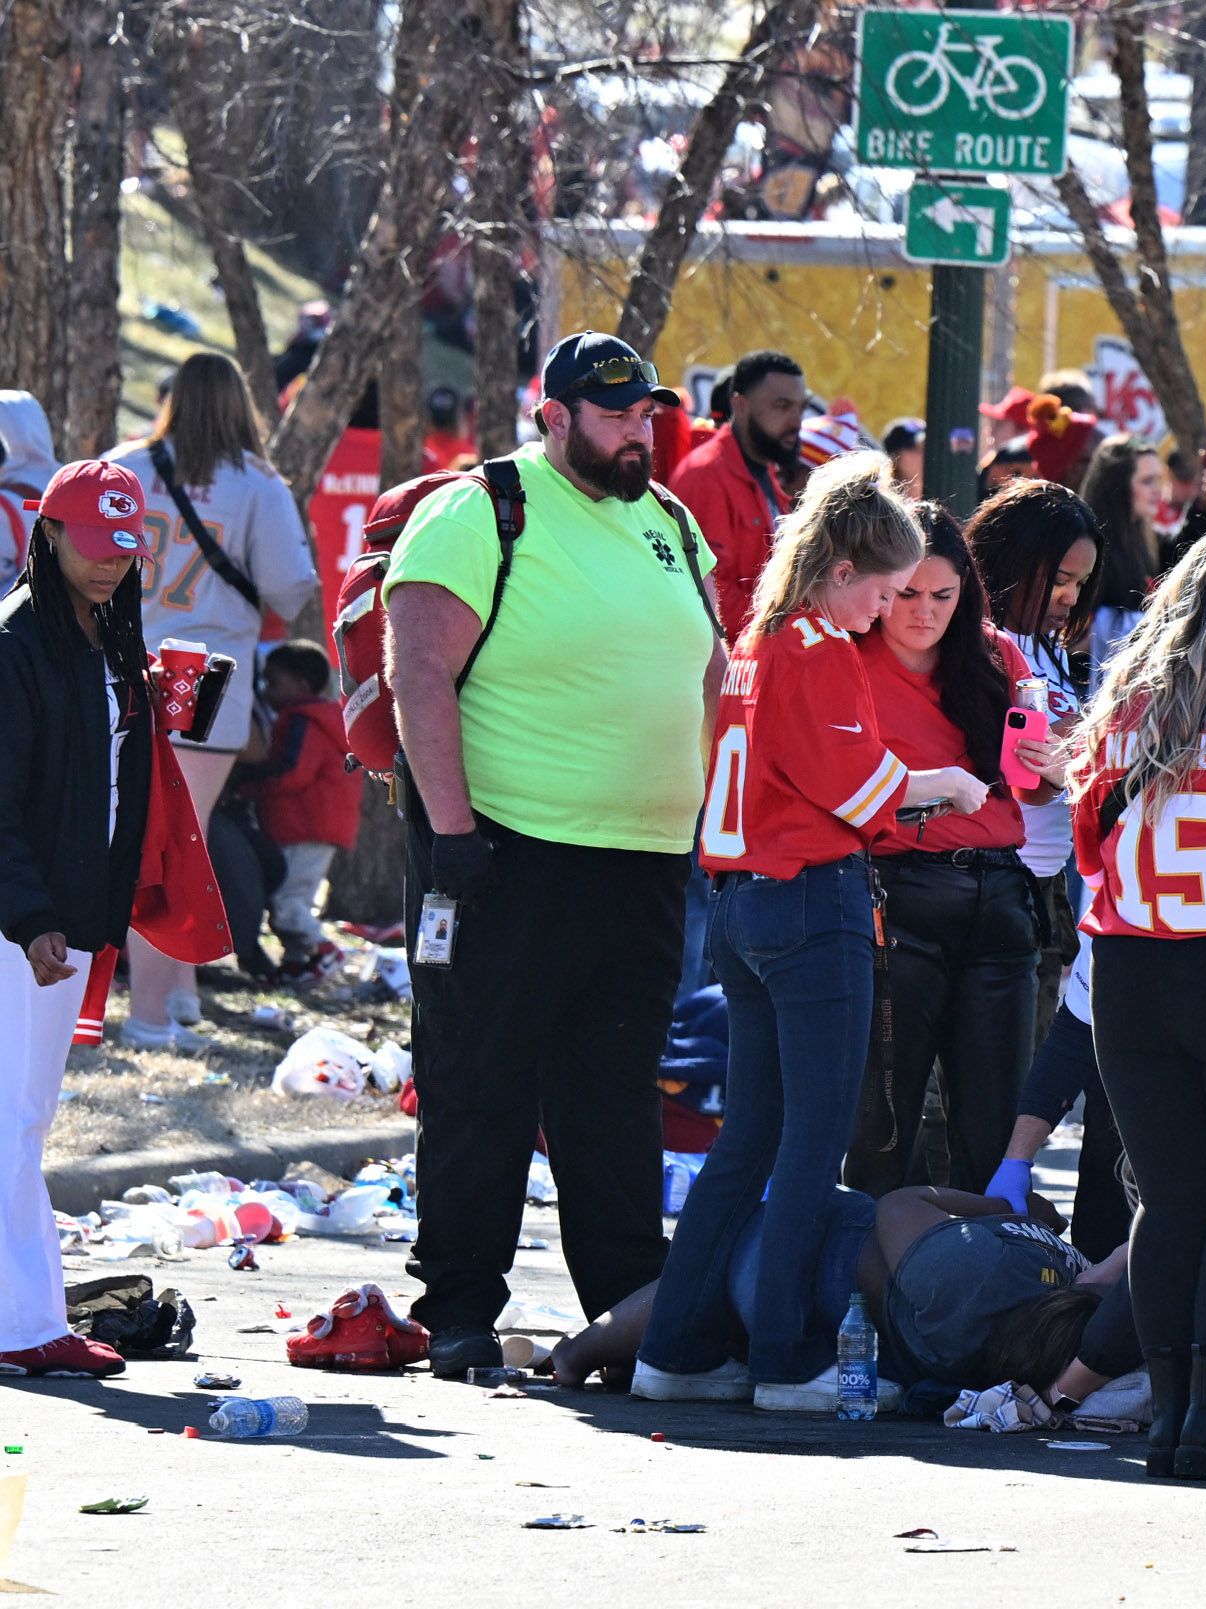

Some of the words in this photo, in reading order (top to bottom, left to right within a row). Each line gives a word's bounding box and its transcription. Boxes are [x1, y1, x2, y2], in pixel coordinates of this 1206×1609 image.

[867, 127, 934, 162] BIKE
[955, 132, 1051, 168] ROUTE
[719, 659, 759, 696] CHECO
[881, 998, 892, 1044] HORNETS
